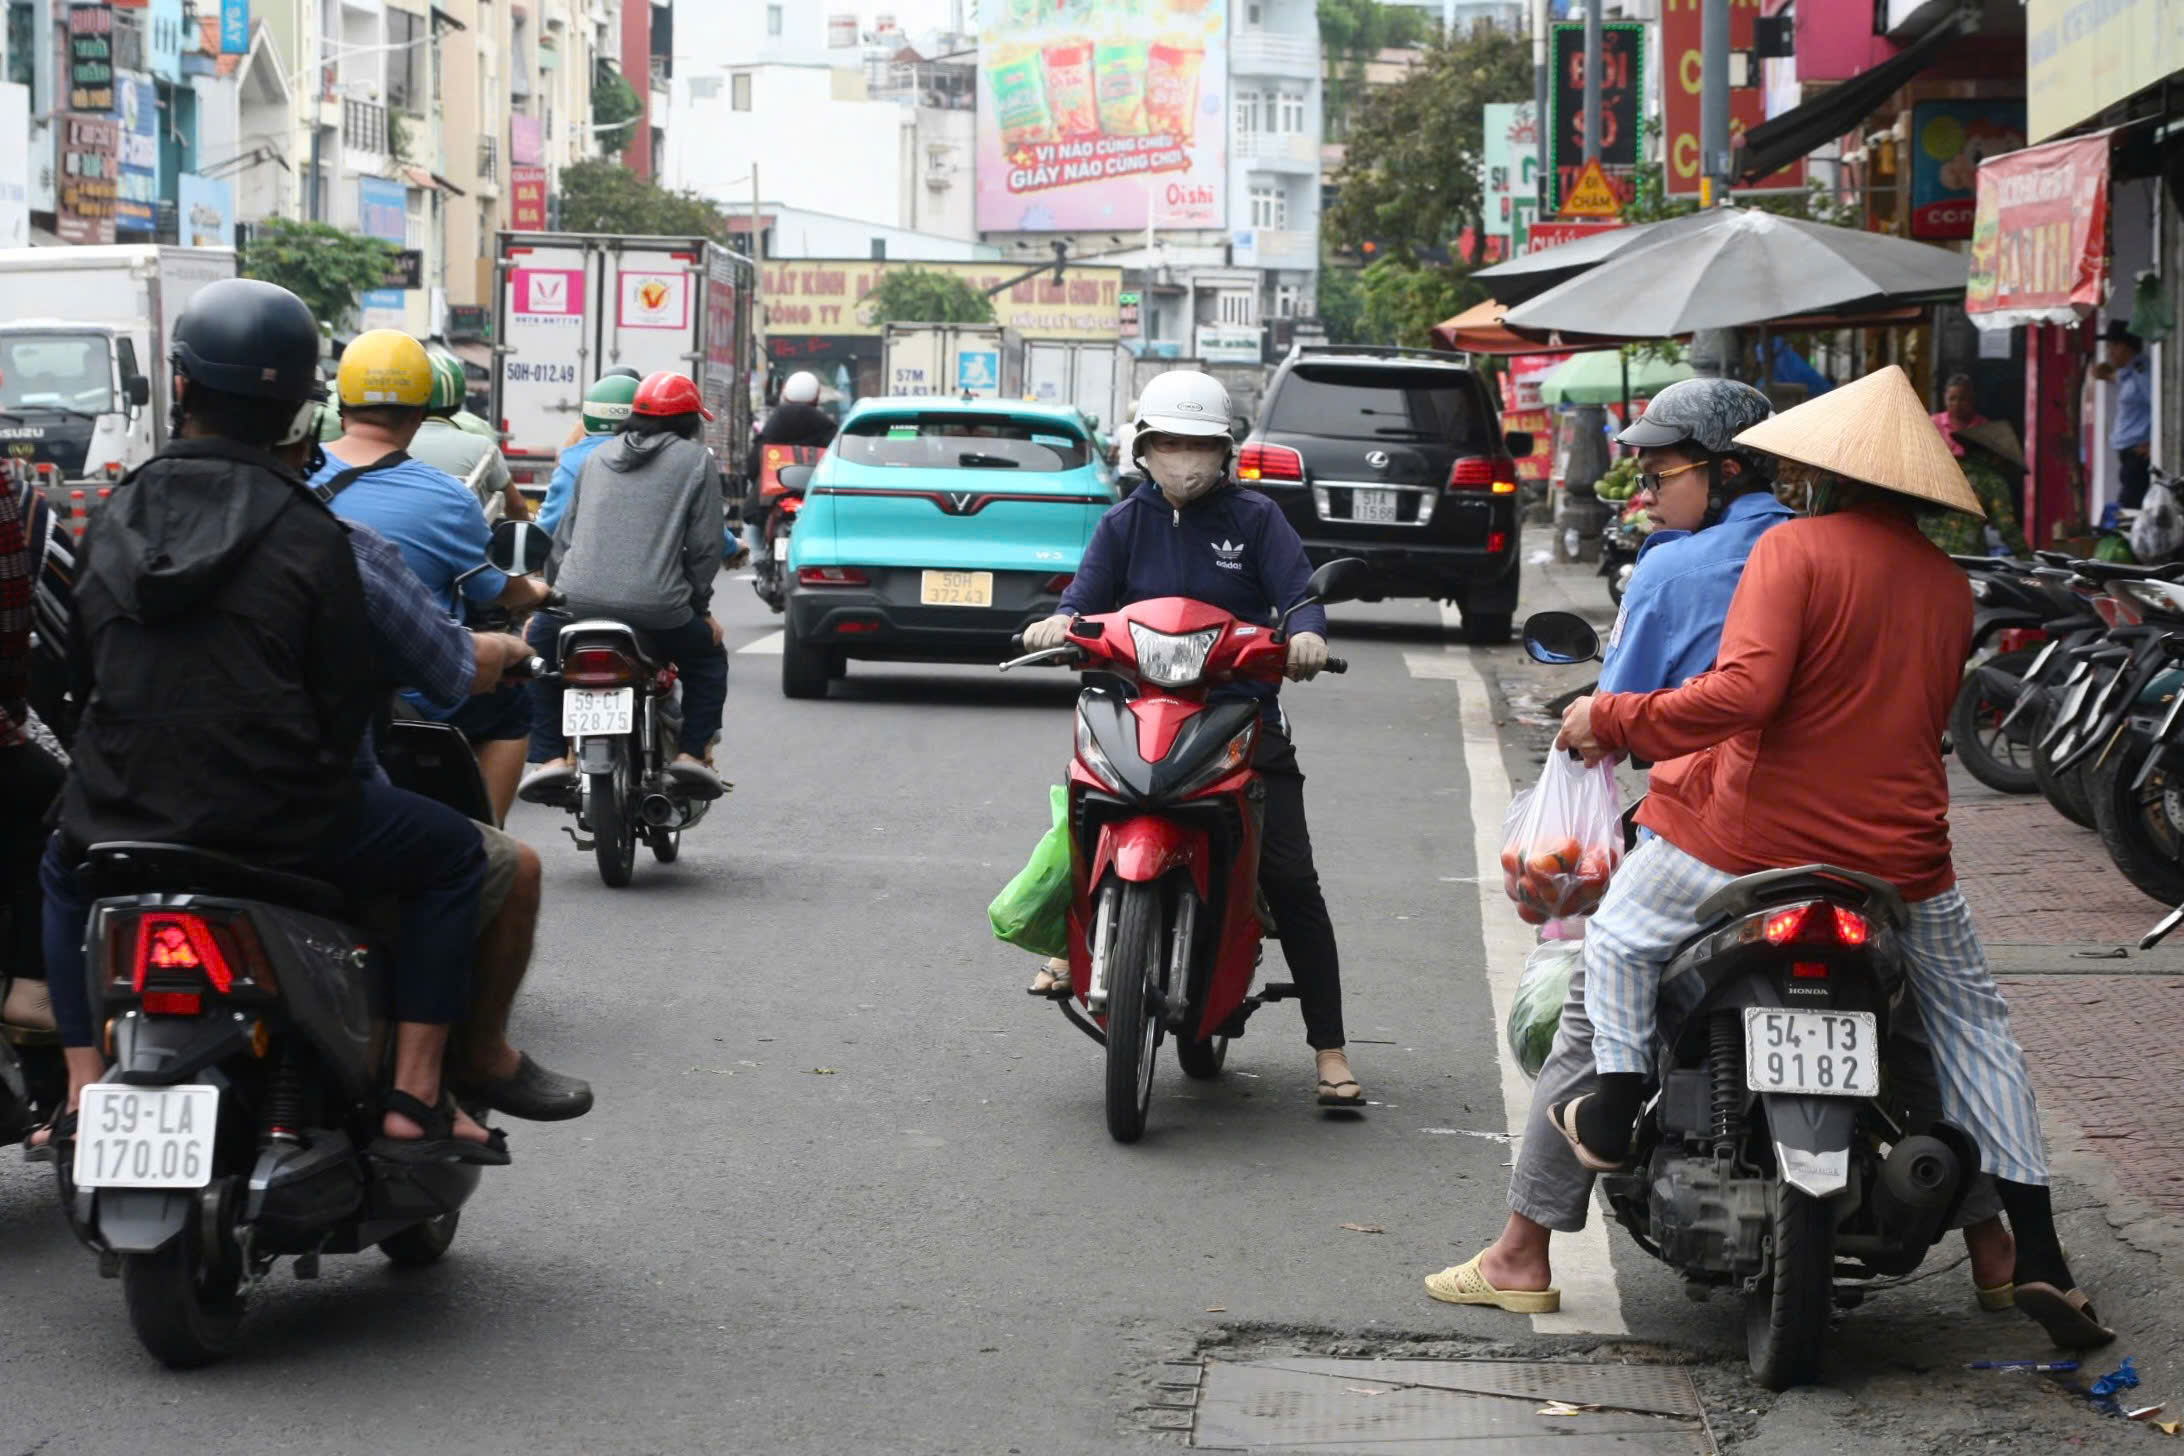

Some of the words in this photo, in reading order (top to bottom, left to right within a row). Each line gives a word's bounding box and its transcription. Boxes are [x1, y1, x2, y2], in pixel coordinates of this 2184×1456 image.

[1059, 140, 1094, 160] NÀO
[1064, 156, 1102, 180] NÀO
[1167, 183, 1214, 206] Oishi
[506, 362, 575, 384] 50H-012.49
[896, 368, 924, 382] 57M
[1215, 560, 1242, 570] adidas
[567, 711, 628, 732] 528.75
[1788, 987, 1829, 996] HONDA
[1766, 1014, 1858, 1052] 54-T3
[1767, 1052, 1859, 1091] 9182
[101, 1094, 194, 1135] 59-LA
[92, 1139, 202, 1180] 170.06
